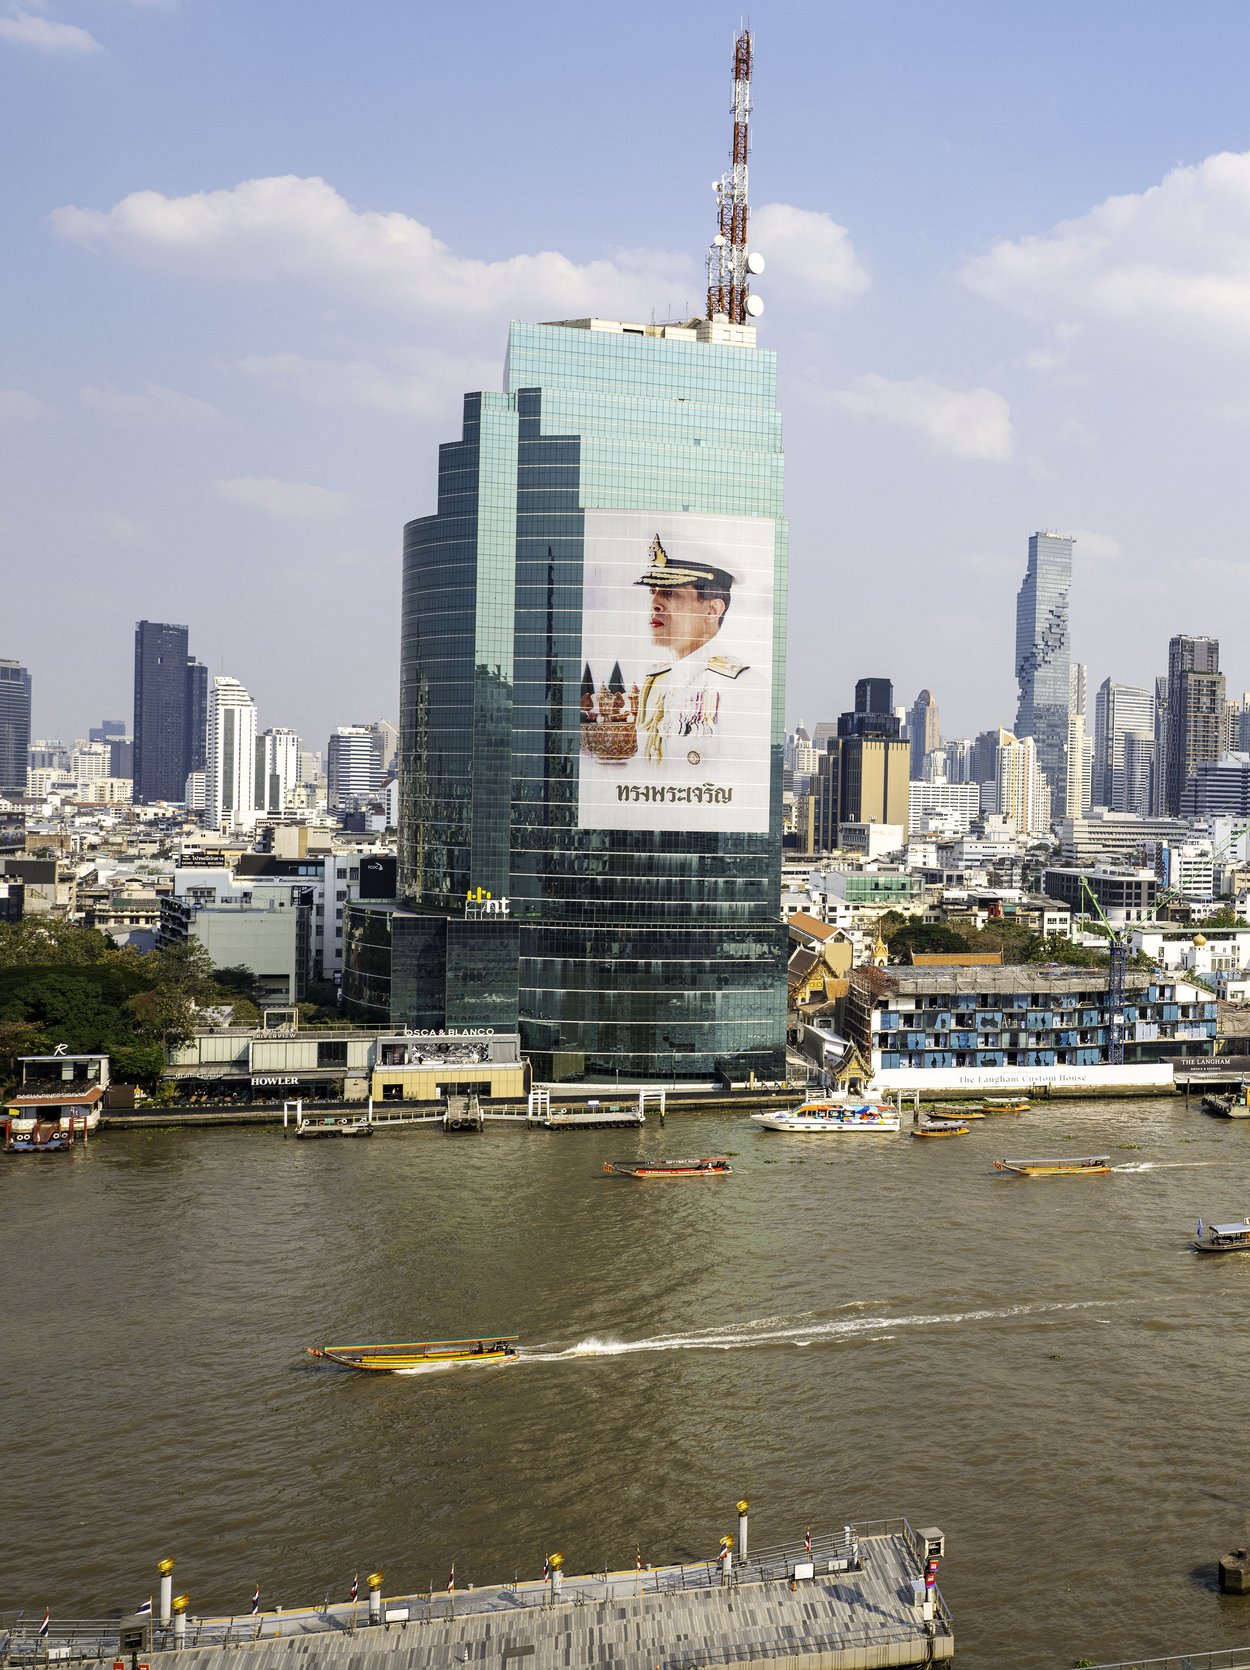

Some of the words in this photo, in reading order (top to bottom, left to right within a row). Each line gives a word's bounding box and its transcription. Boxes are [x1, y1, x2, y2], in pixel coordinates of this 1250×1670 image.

[616, 782, 733, 804] ทรงพระเจริญ
[448, 1028, 495, 1036] BLANCO
[251, 1077, 299, 1086] HOWLER
[978, 1075, 1019, 1084] Langham
[1021, 1074, 1057, 1082] Custom
